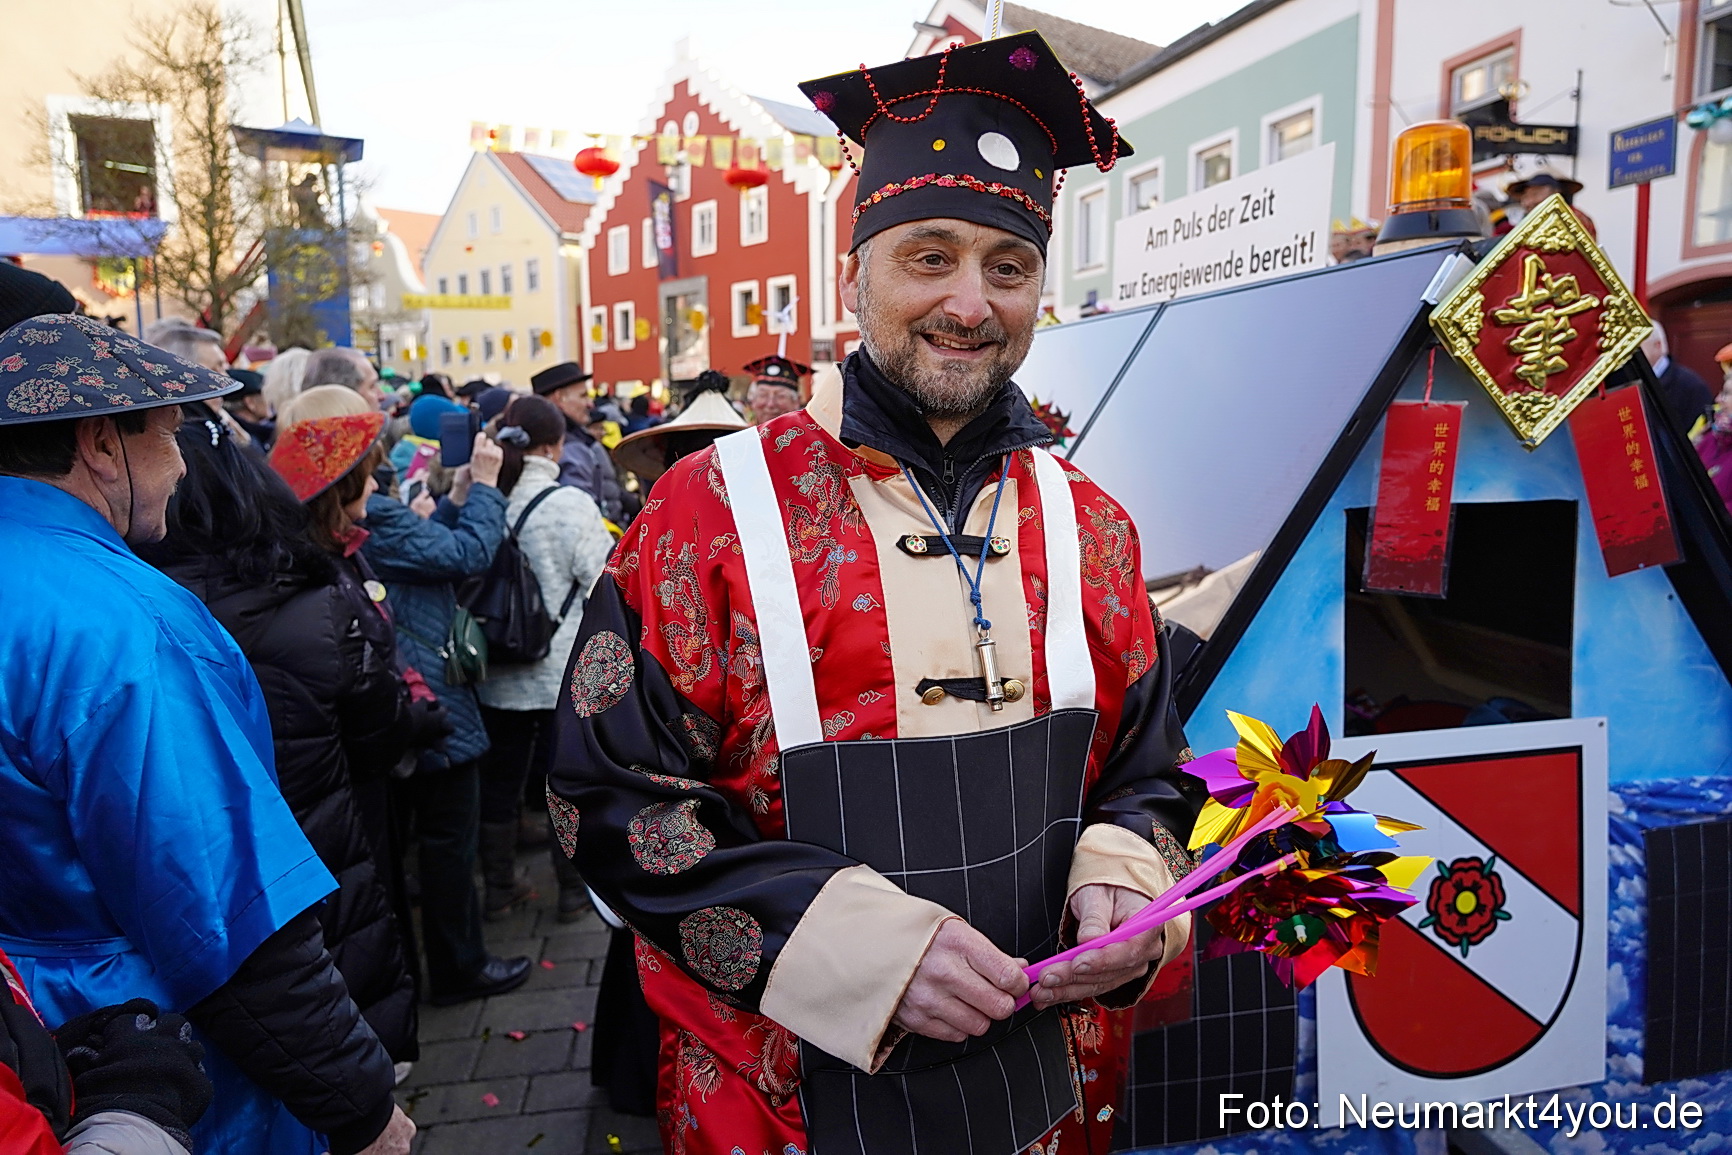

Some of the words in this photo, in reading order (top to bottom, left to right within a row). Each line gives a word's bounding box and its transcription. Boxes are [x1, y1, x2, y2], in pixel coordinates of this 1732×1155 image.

[1145, 226, 1168, 251] Am
[1173, 211, 1203, 243] Puls
[1208, 203, 1235, 232] der
[1240, 187, 1276, 224] Zeit
[1119, 281, 1138, 300] zur
[1142, 250, 1243, 299] Energiewende
[1249, 231, 1316, 274] bereit!
[1425, 422, 1450, 512] 世界的幸福
[1618, 406, 1650, 491] 世界的幸福
